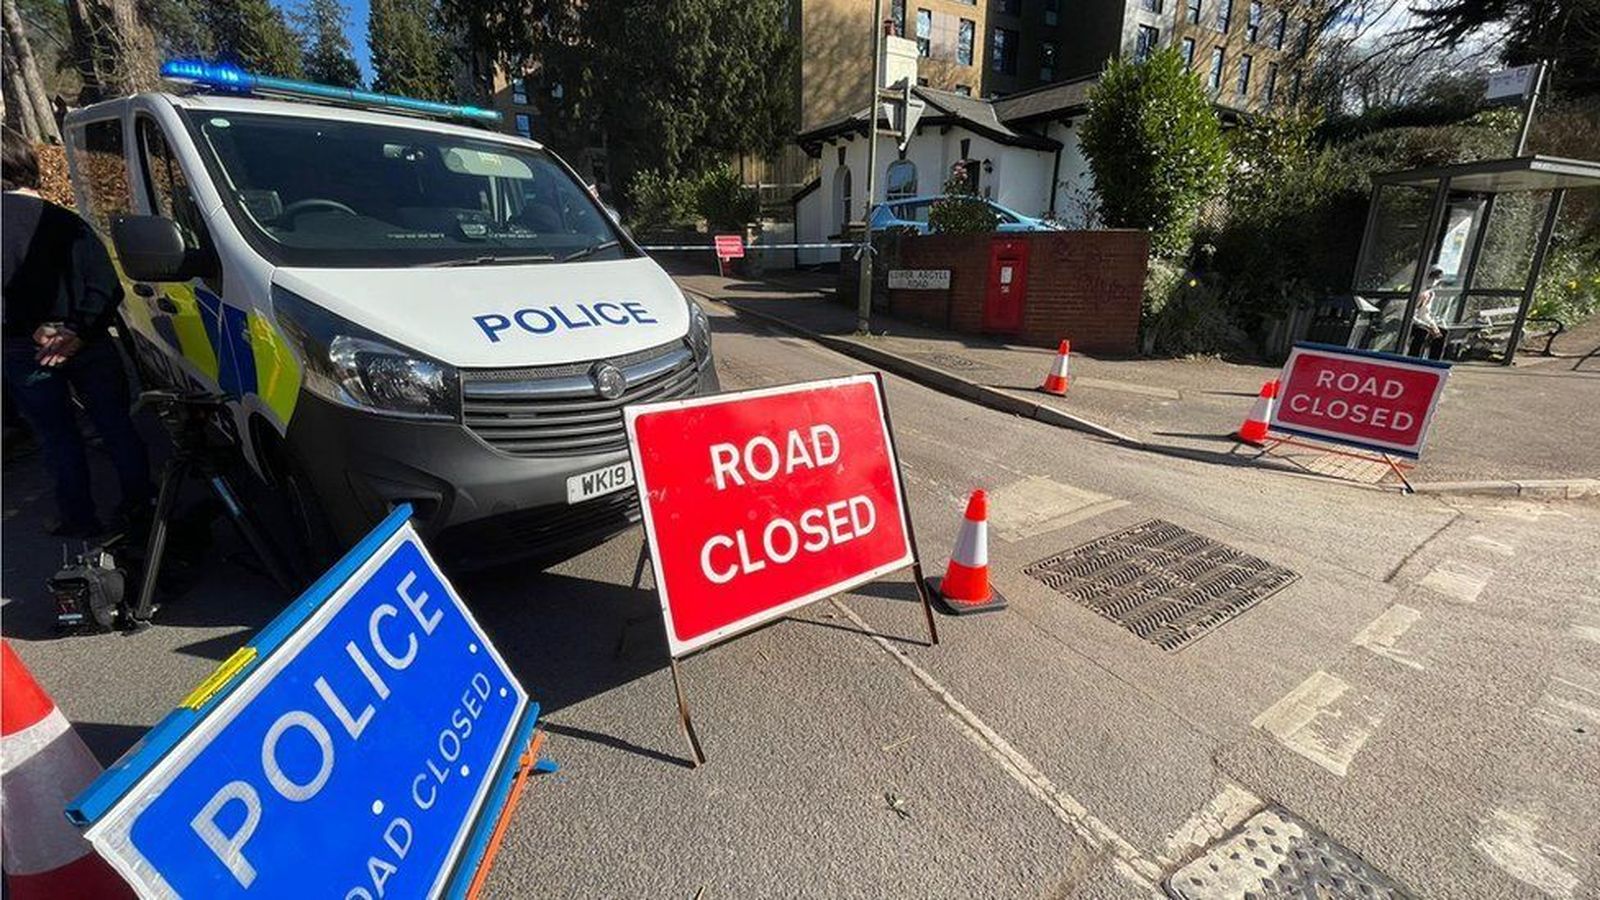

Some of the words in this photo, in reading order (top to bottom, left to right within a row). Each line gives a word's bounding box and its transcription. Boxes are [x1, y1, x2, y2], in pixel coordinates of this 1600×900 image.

[473, 302, 657, 343] POLICE
[1316, 370, 1404, 399] ROAD
[1290, 394, 1414, 431] CLOSED
[582, 466, 626, 495] WK19
[710, 423, 840, 491] ROAD
[701, 494, 877, 584] CLOSED
[190, 570, 444, 890] POLICE
[412, 672, 491, 810] CLOSED
